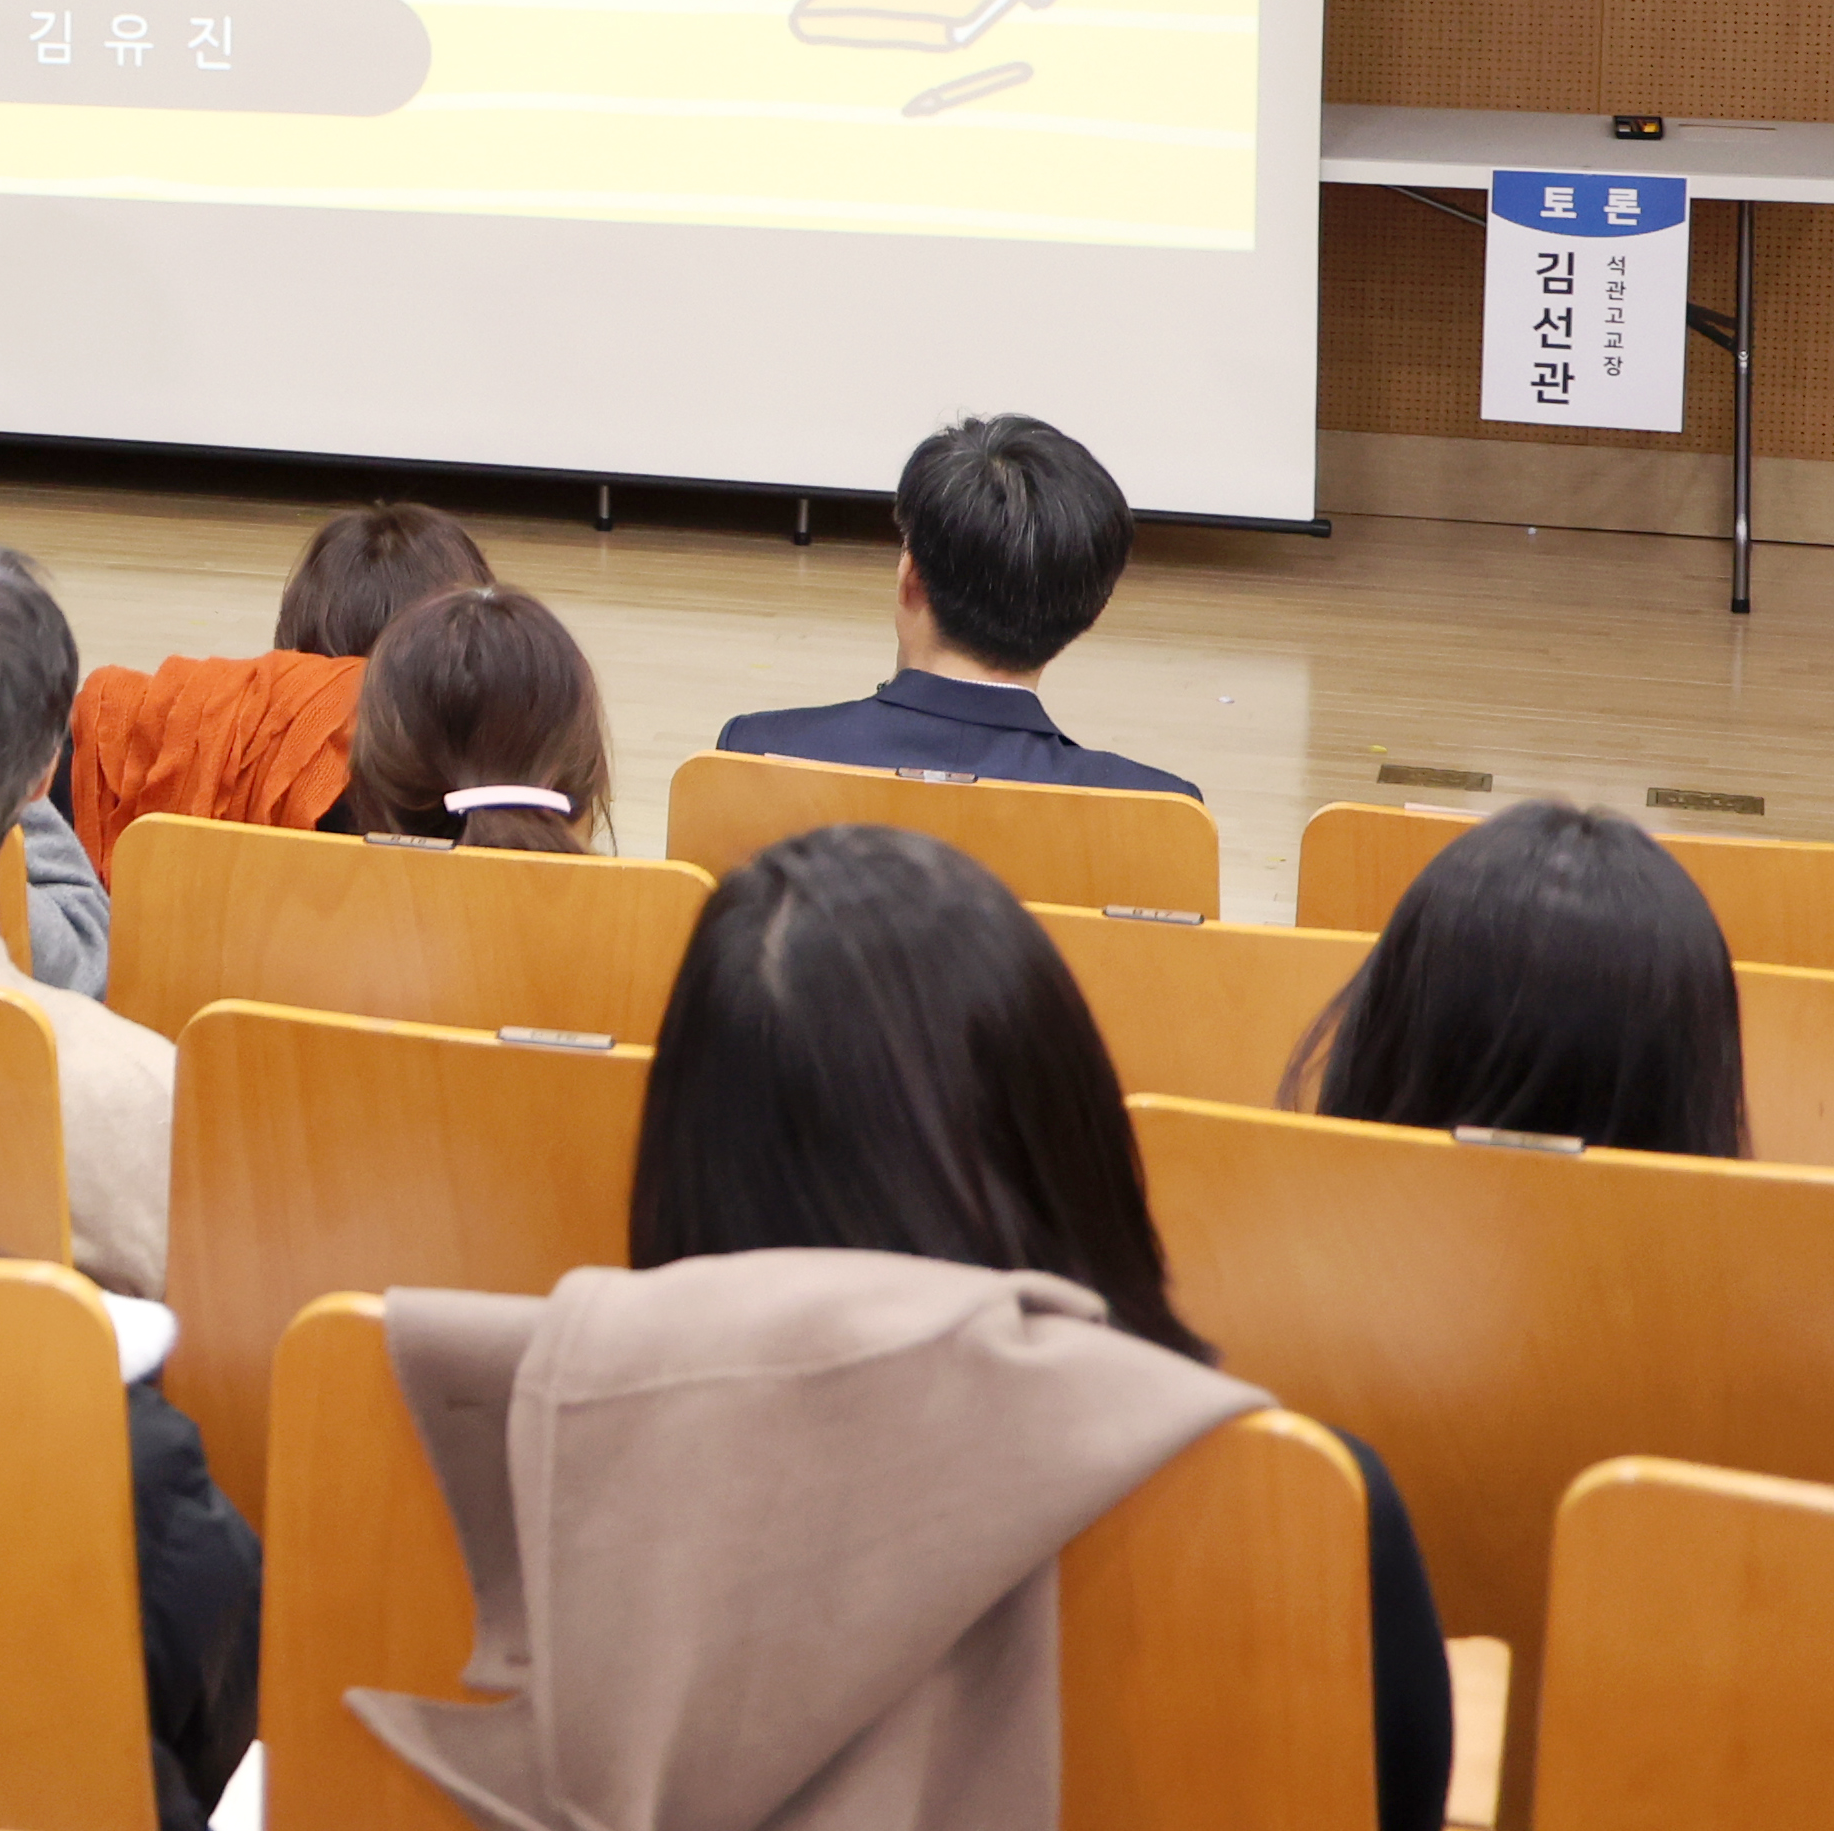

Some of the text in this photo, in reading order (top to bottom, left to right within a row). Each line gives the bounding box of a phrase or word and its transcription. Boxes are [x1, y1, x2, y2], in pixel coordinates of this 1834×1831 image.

[29, 10, 233, 71] 김유진
[1539, 186, 1642, 226] 토론
[1530, 251, 1577, 405] 김선관
